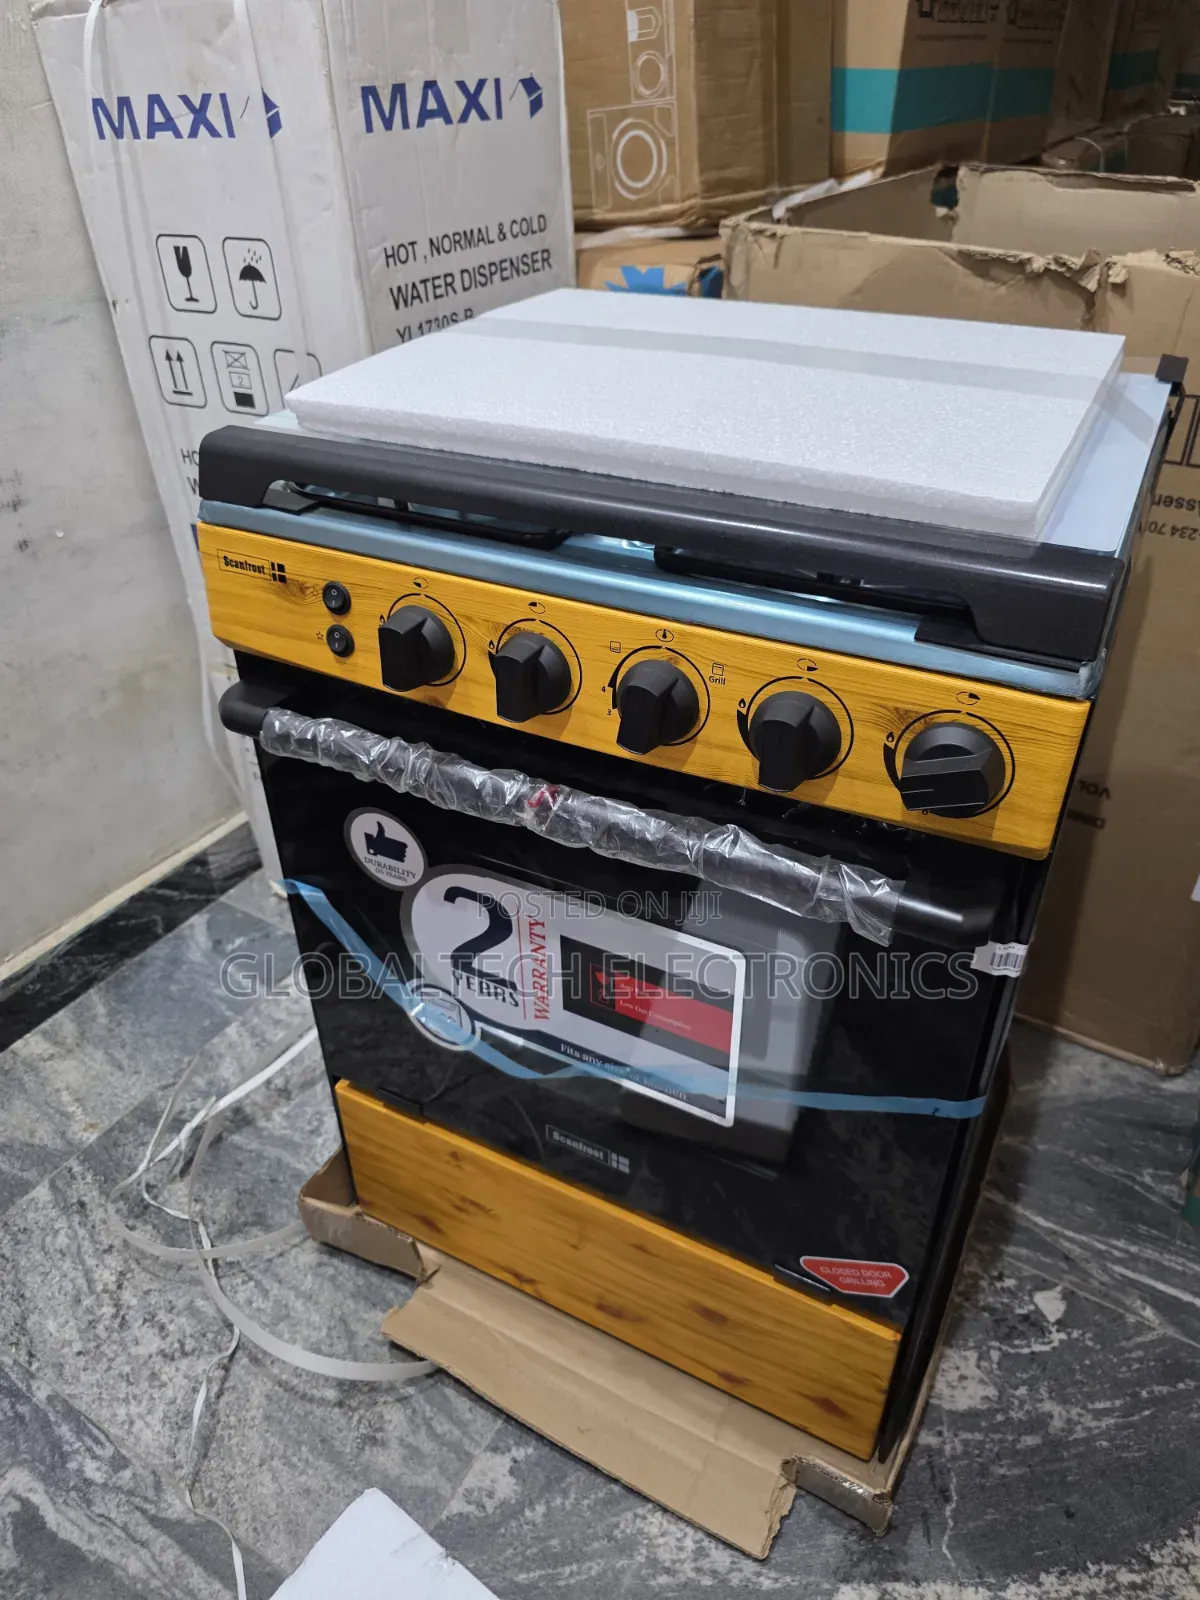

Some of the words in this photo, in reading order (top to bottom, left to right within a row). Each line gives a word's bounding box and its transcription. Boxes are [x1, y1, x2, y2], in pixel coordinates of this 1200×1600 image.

[91, 92, 236, 141] MAXI
[360, 77, 504, 134] MAXI
[429, 226, 495, 257] NORMAL
[497, 222, 507, 242] &
[510, 214, 547, 239] COLD
[389, 272, 458, 310] WATER
[460, 249, 553, 292] DISPENSER
[223, 555, 266, 575] Scanfrost
[708, 675, 726, 685] Grill
[364, 856, 417, 880] DURABILITY
[443, 885, 518, 992] 2
[451, 967, 520, 1008] YEARS
[528, 914, 550, 1021] WARRANTY
[560, 1043, 580, 1058] Fits
[582, 1053, 603, 1067] any
[819, 1266, 860, 1277] CLOSED
[861, 1268, 893, 1279] DOOR
[839, 1276, 886, 1288] GRILLING
